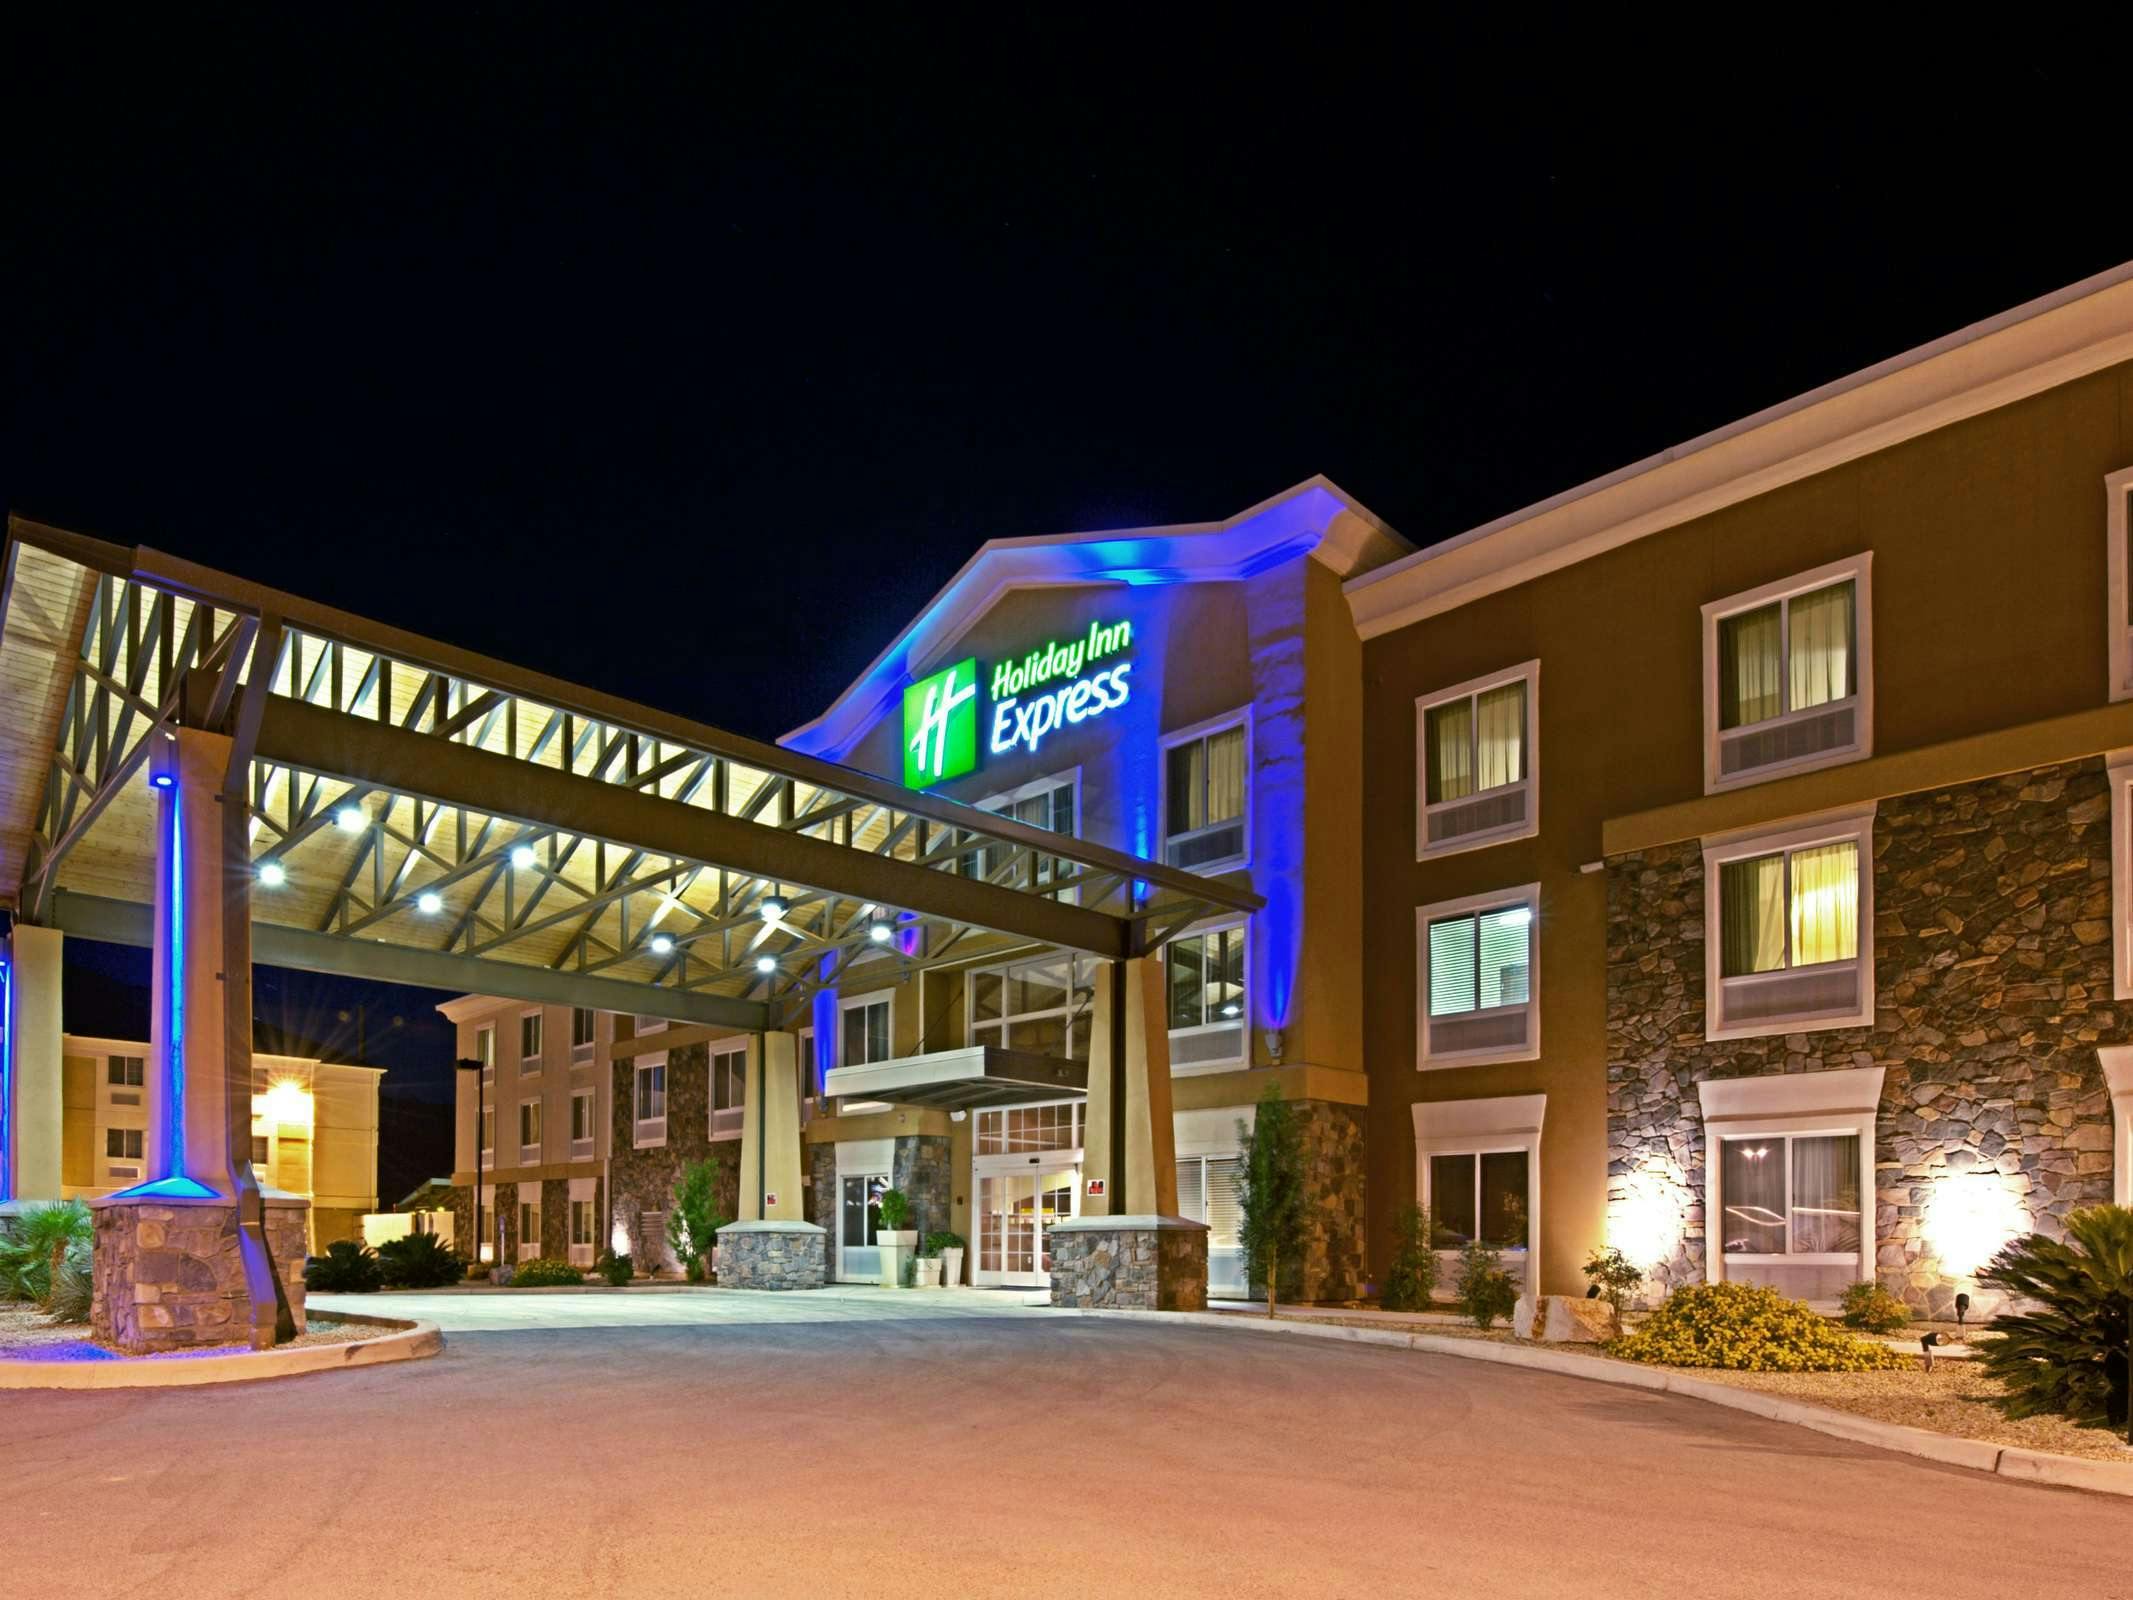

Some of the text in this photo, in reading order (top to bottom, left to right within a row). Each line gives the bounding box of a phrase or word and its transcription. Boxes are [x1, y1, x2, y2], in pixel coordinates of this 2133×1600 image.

[991, 620, 1132, 701] Holiday Inn
[990, 663, 1132, 753] Express
